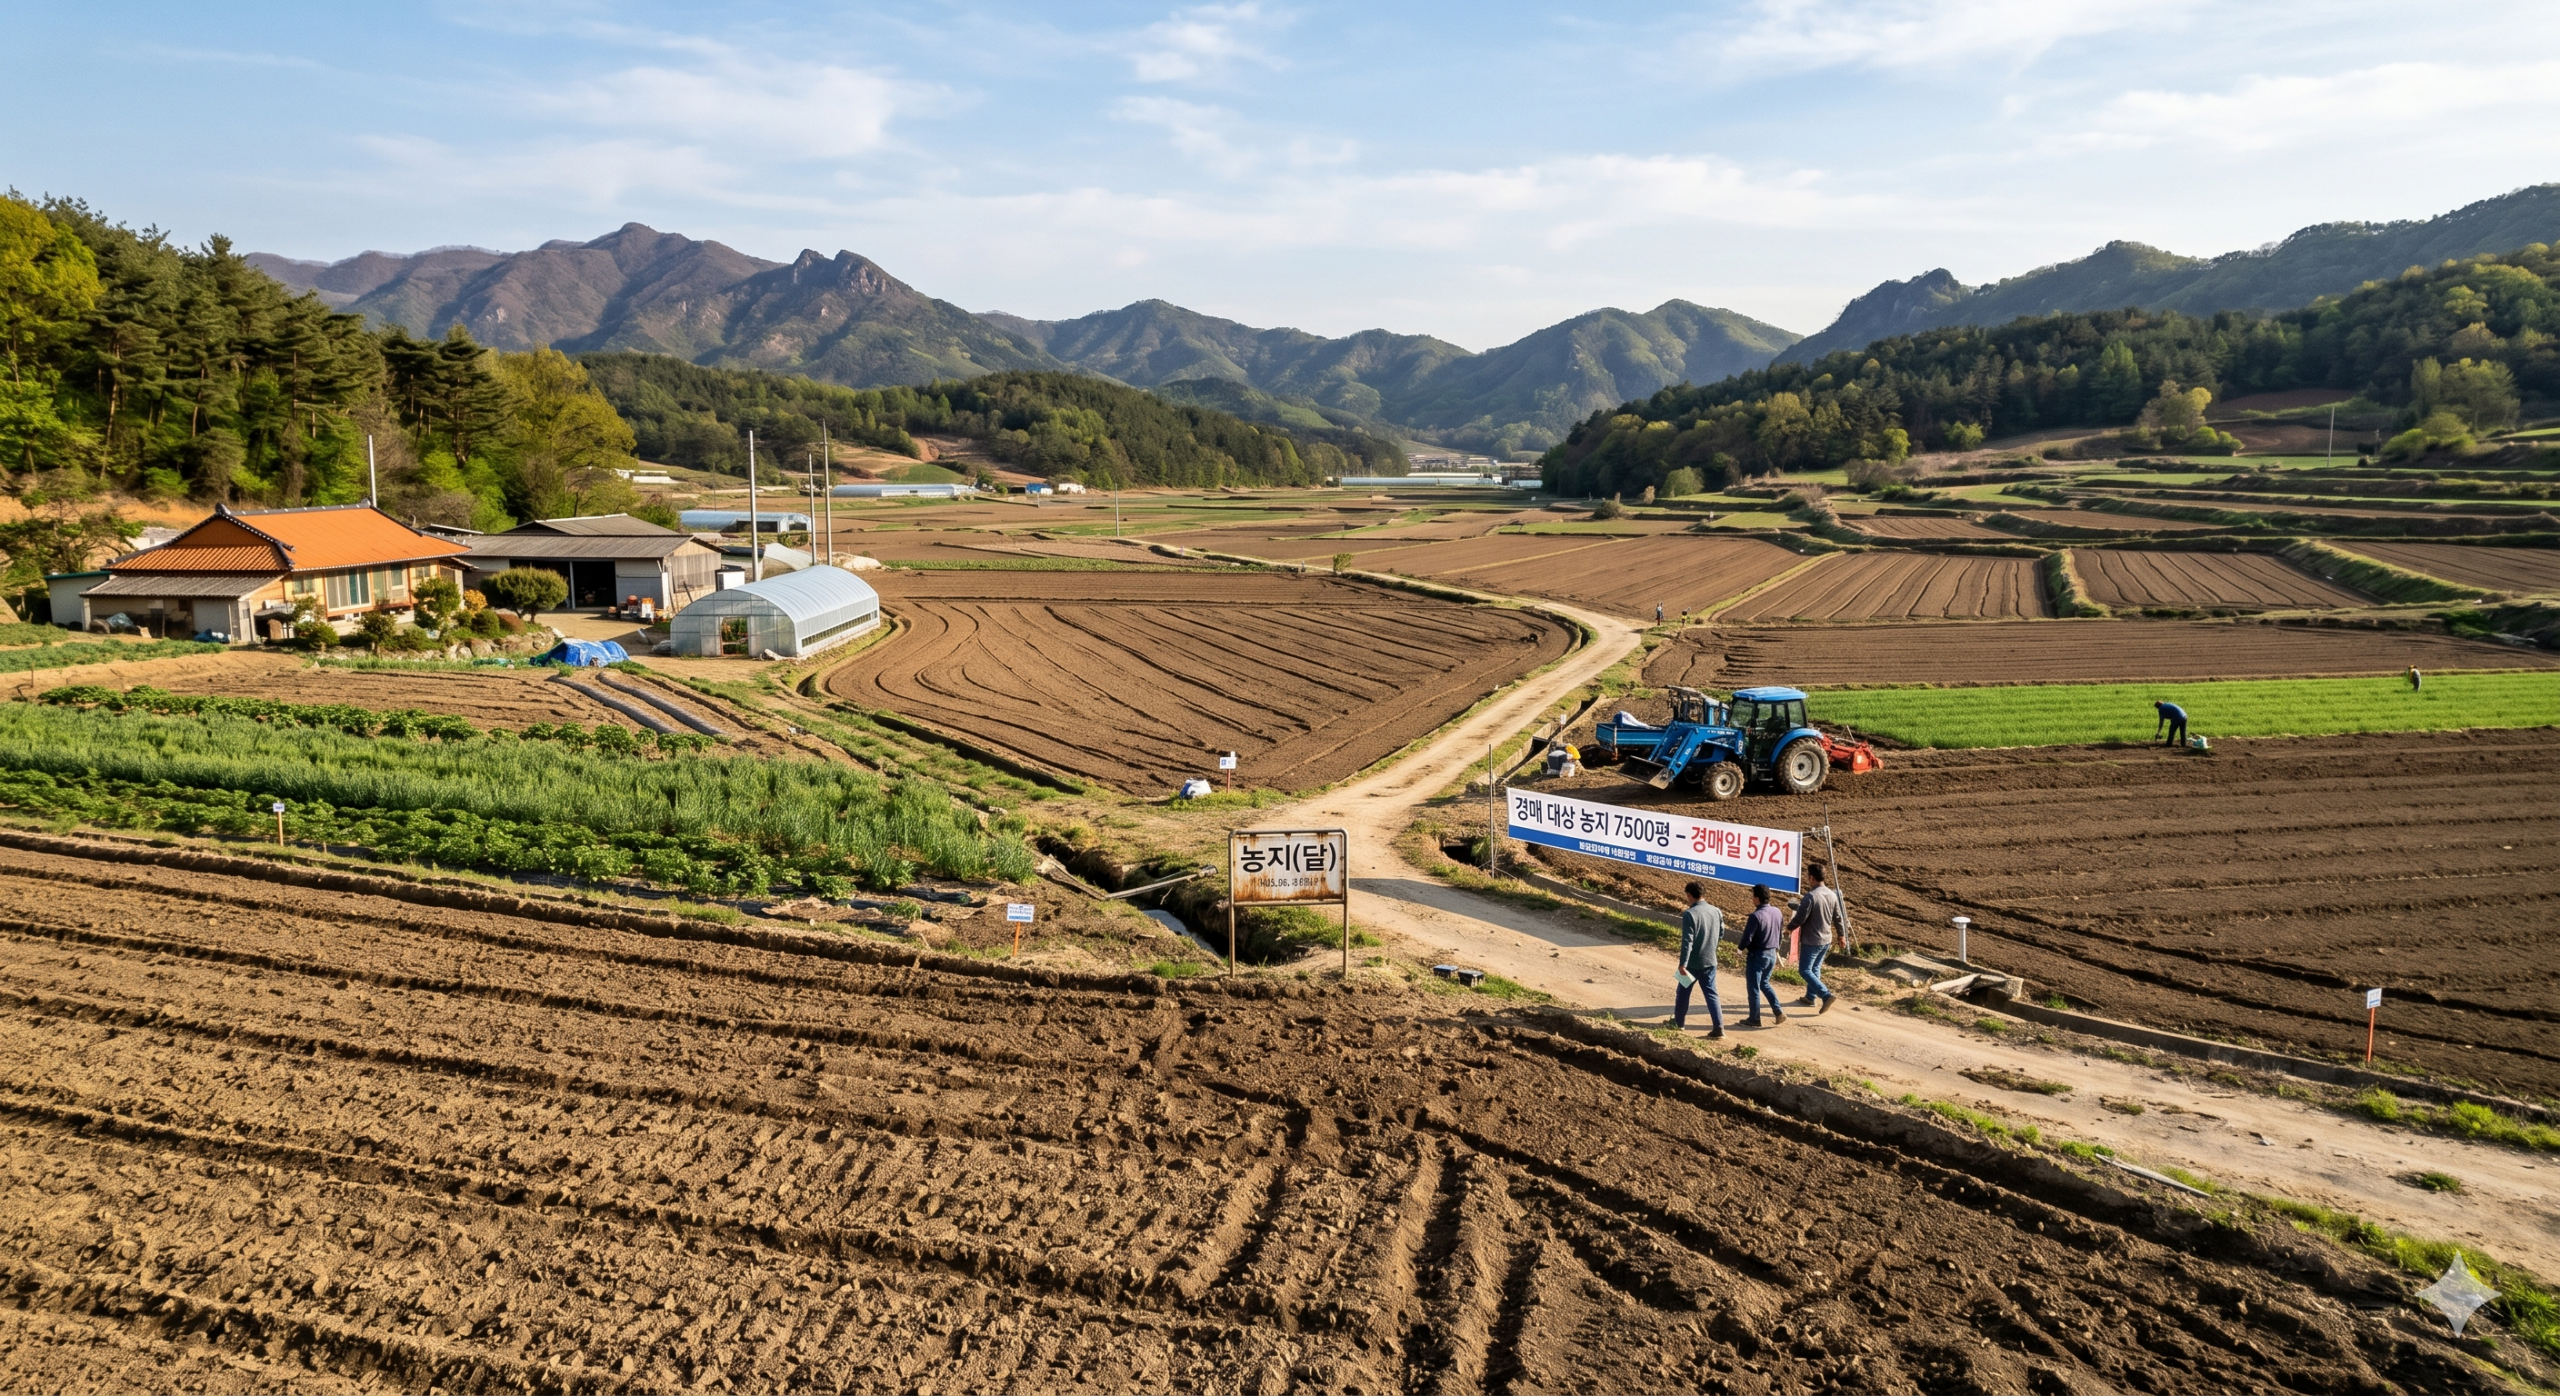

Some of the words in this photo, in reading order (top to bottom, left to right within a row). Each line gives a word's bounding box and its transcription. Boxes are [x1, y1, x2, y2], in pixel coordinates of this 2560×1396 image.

[1515, 797, 1542, 824] 경매
[1547, 803, 1575, 830] 대상
[1580, 808, 1609, 836] 농지
[1614, 815, 1670, 847] 7500평
[1691, 826, 1741, 859] 경매일
[1747, 836, 1790, 866] 5/21
[1240, 842, 1337, 873] 농지(달)
